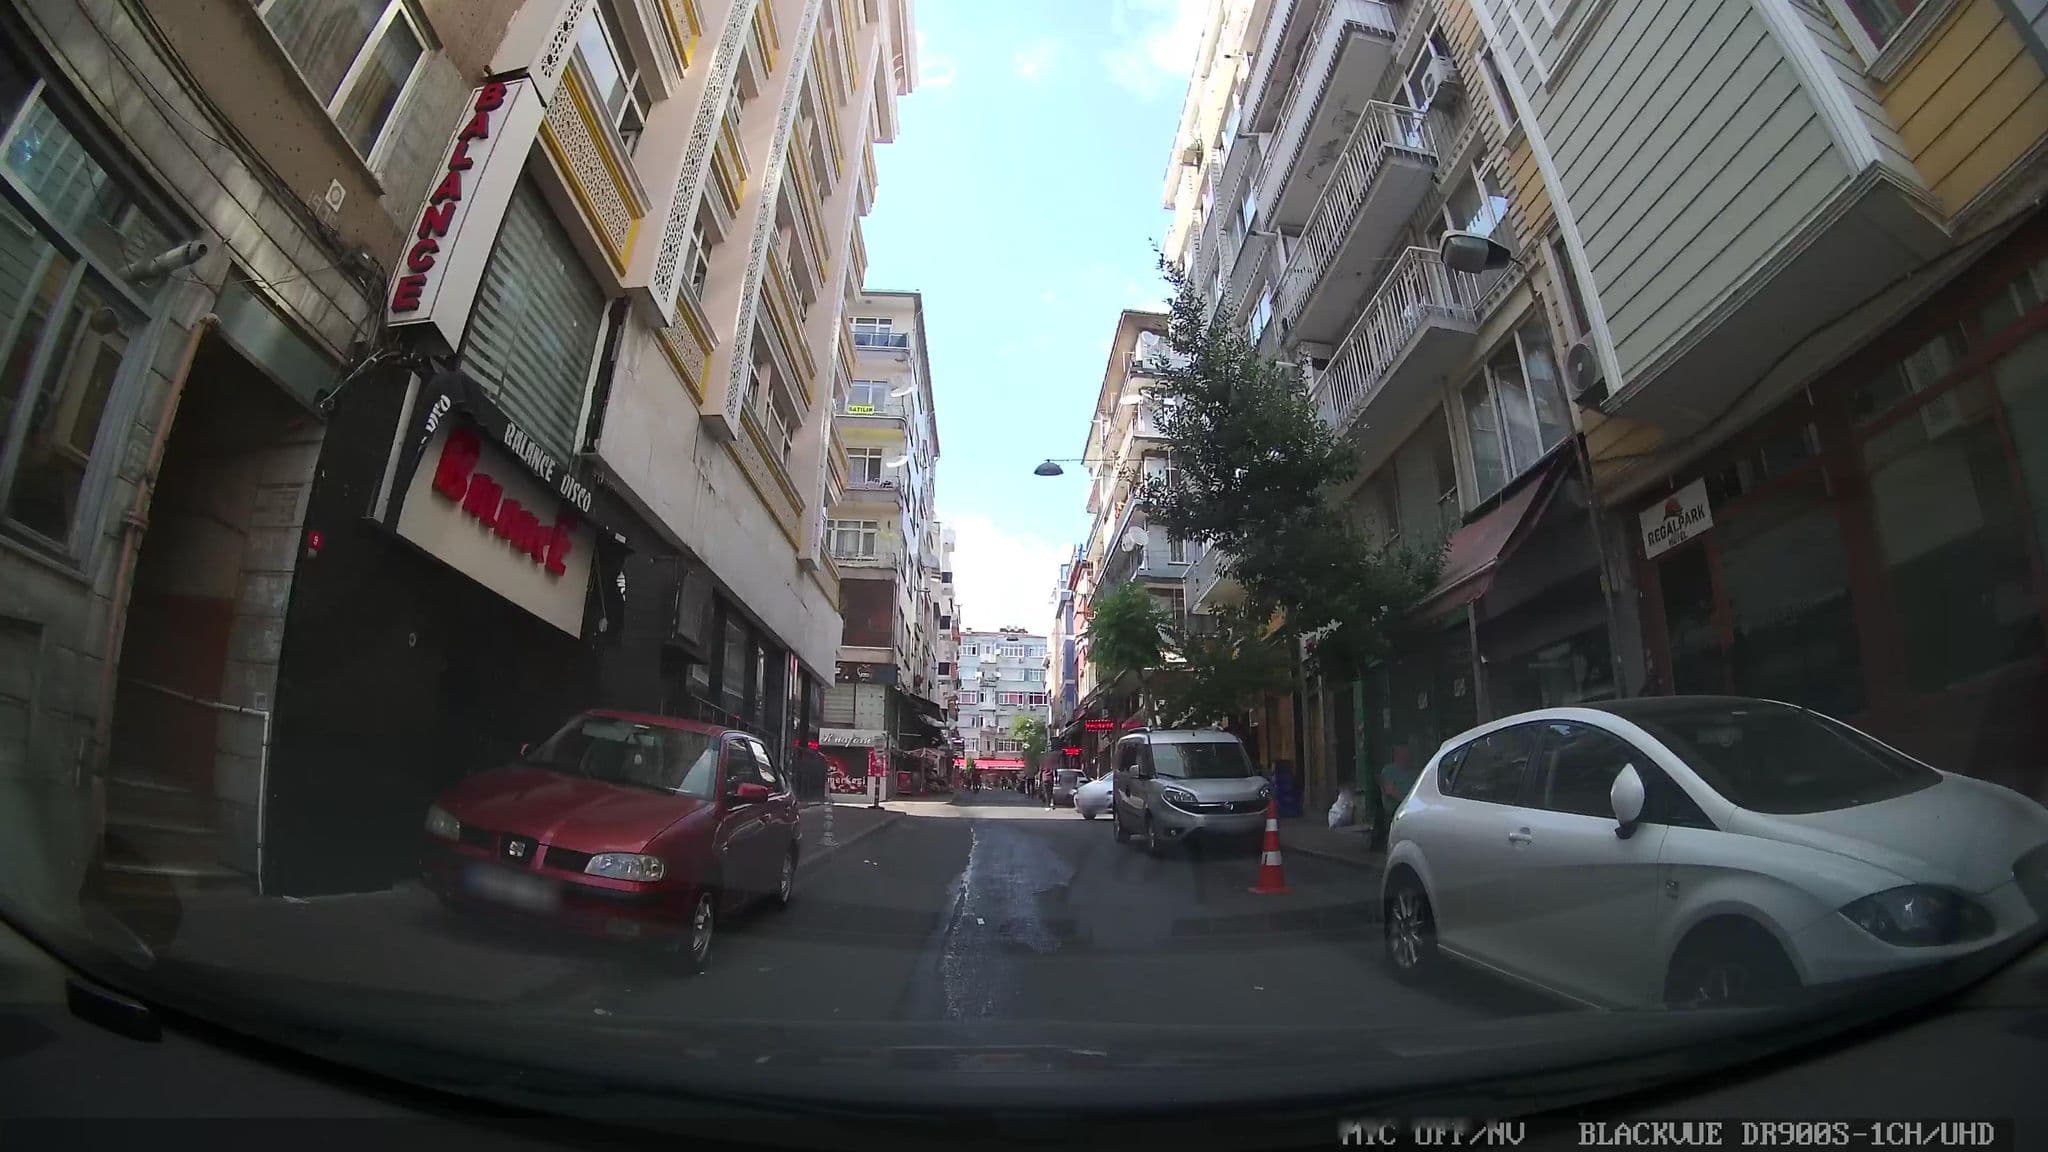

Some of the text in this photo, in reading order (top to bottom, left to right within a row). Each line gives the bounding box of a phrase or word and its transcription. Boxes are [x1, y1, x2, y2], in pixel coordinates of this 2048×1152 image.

[391, 82, 507, 313] BALANCE
[504, 422, 592, 513] BALANCE DISCO
[1647, 504, 1705, 546] REGALPARK
